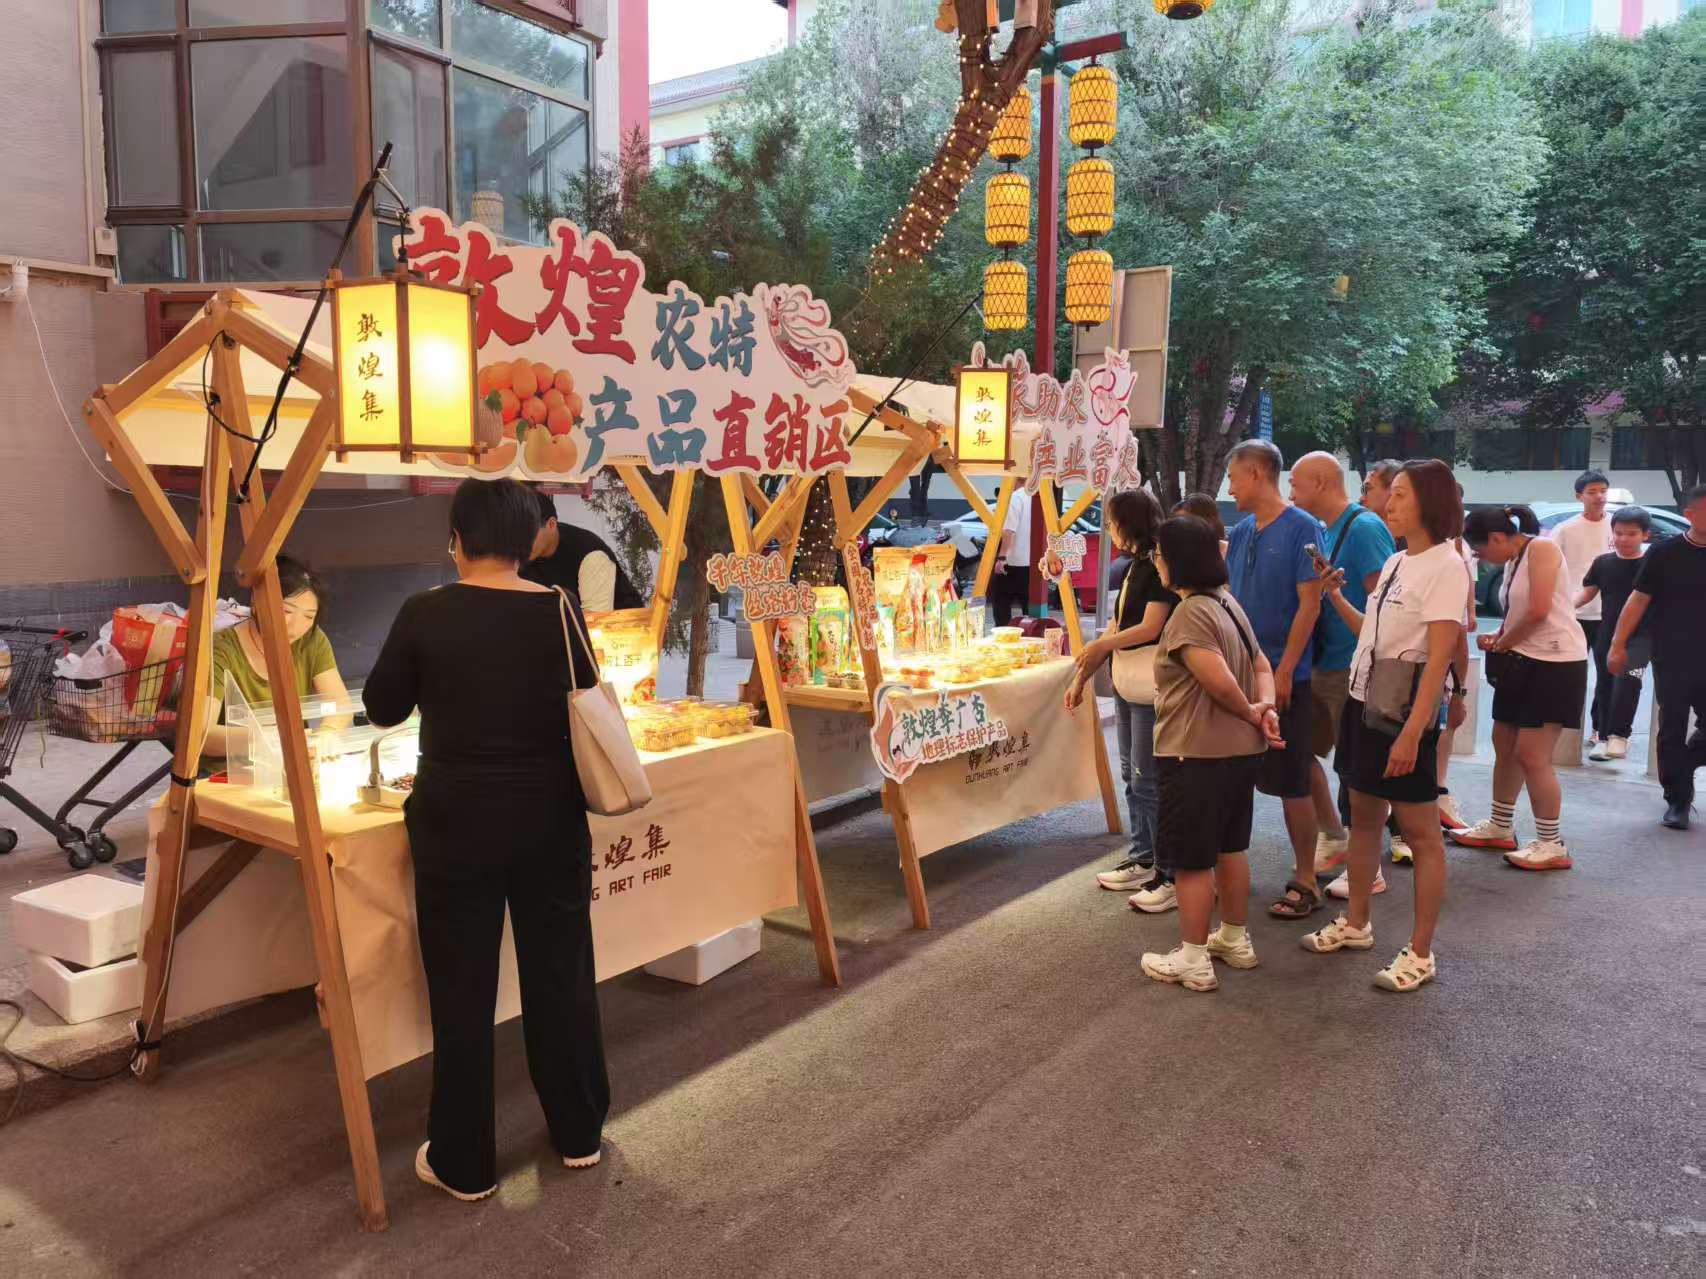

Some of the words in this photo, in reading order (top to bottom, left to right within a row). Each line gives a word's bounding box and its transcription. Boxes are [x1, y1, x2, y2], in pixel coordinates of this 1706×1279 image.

[357, 312, 384, 421] 敦煌集
[972, 386, 995, 448] 敦煌集
[1029, 431, 1138, 492] 产业富农
[711, 556, 786, 588] 千年敦煌
[901, 692, 986, 746] 敦煌李广杏
[922, 720, 1008, 760] 地理标志保护产品
[592, 824, 671, 870] 煌集
[609, 876, 635, 896] ART
[643, 864, 671, 885] FAIR
